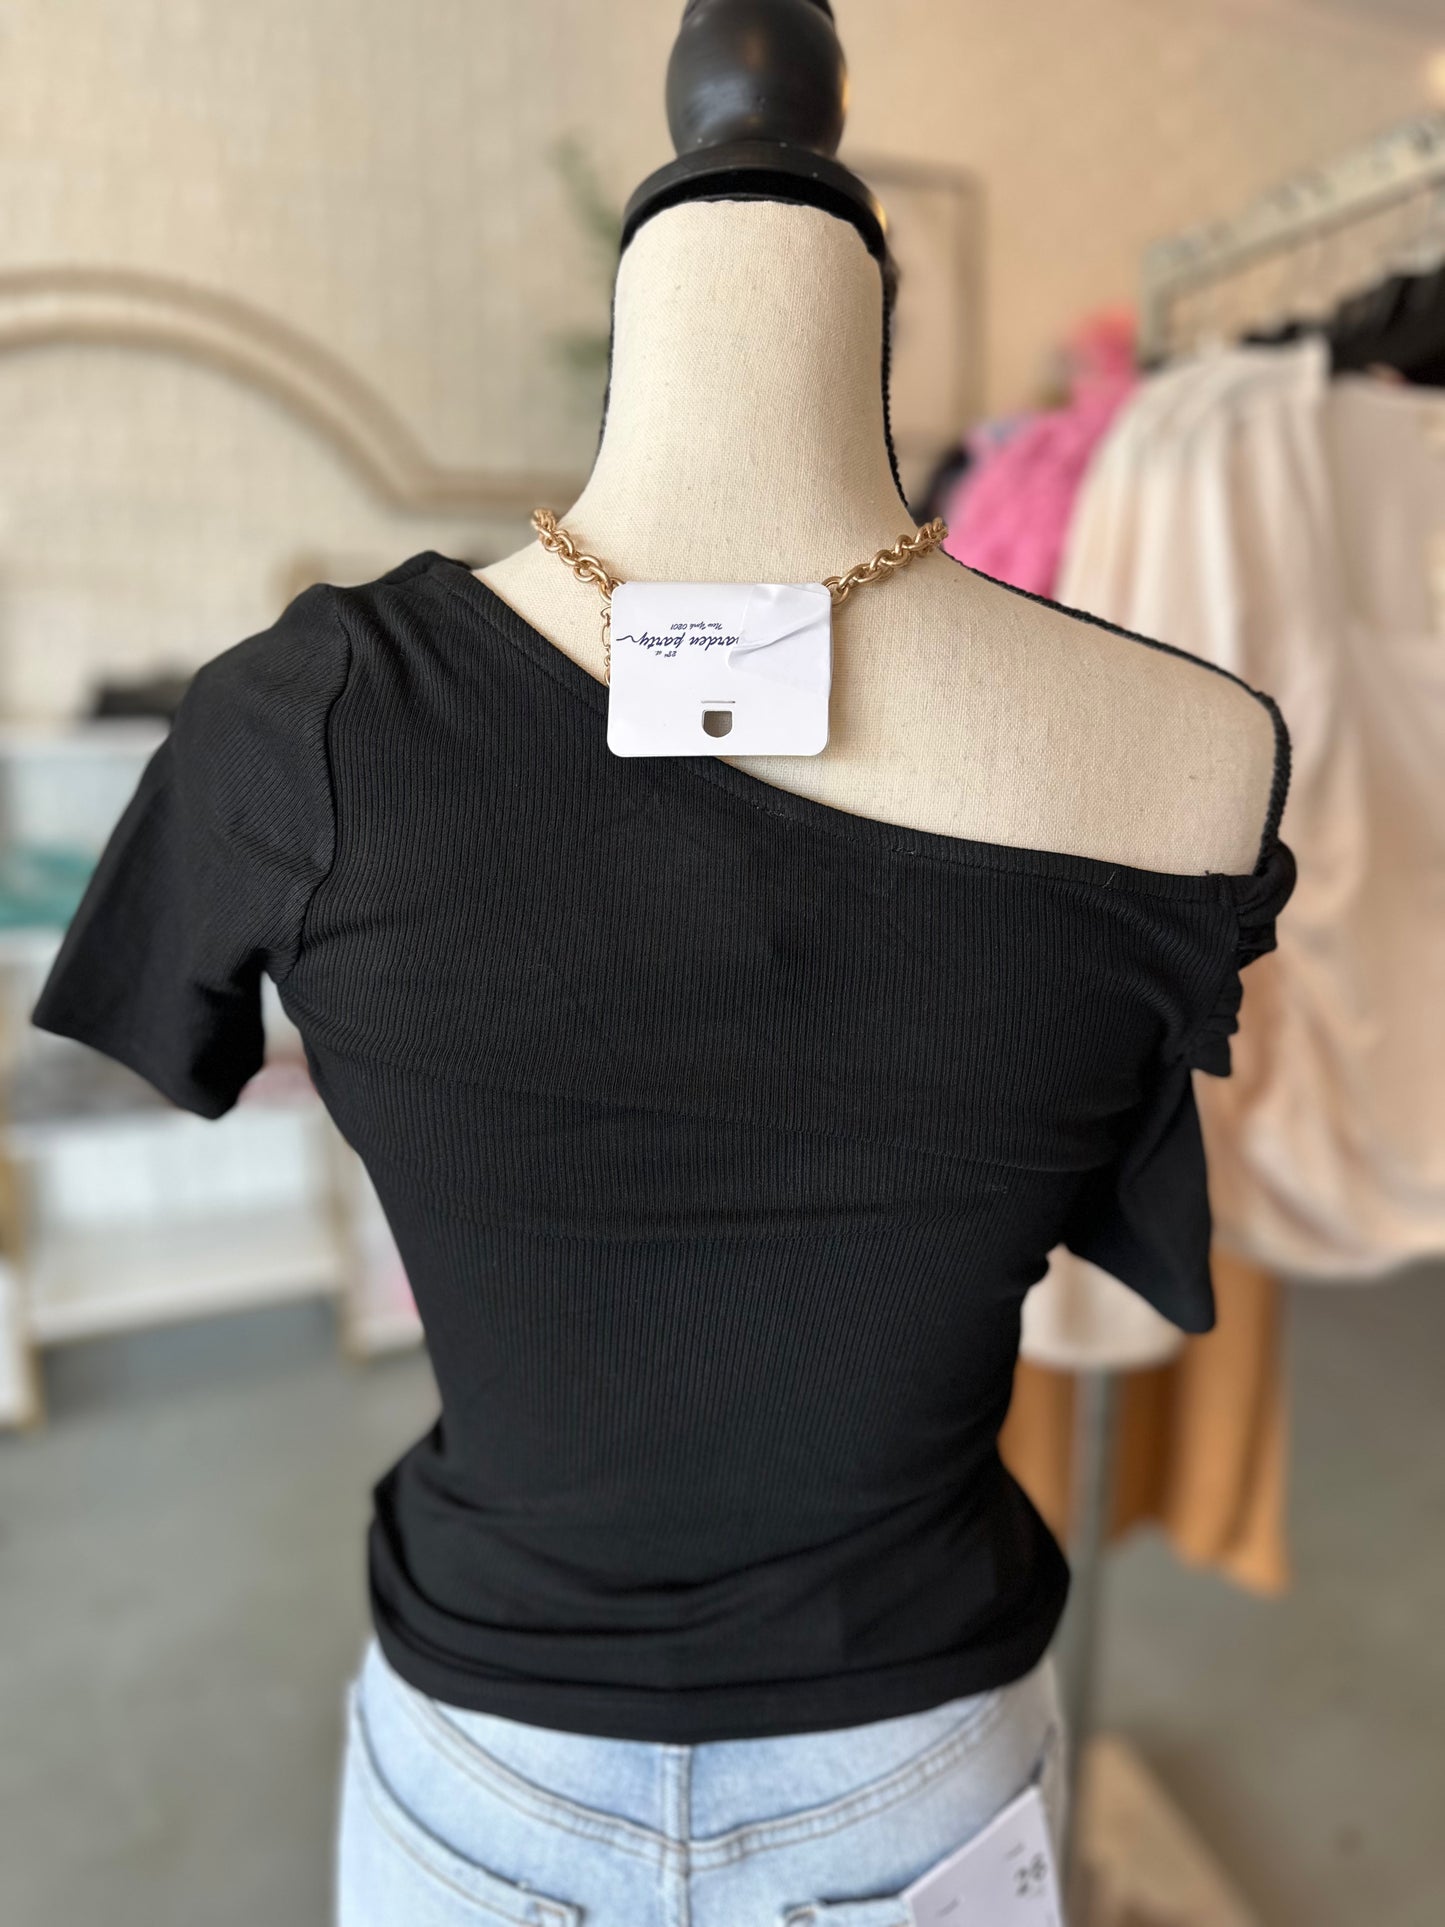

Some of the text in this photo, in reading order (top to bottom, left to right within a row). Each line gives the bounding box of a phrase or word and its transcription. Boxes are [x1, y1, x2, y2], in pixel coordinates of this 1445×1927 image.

[689, 621, 706, 630] York
[707, 622, 723, 630] New
[616, 631, 739, 651] arden party
